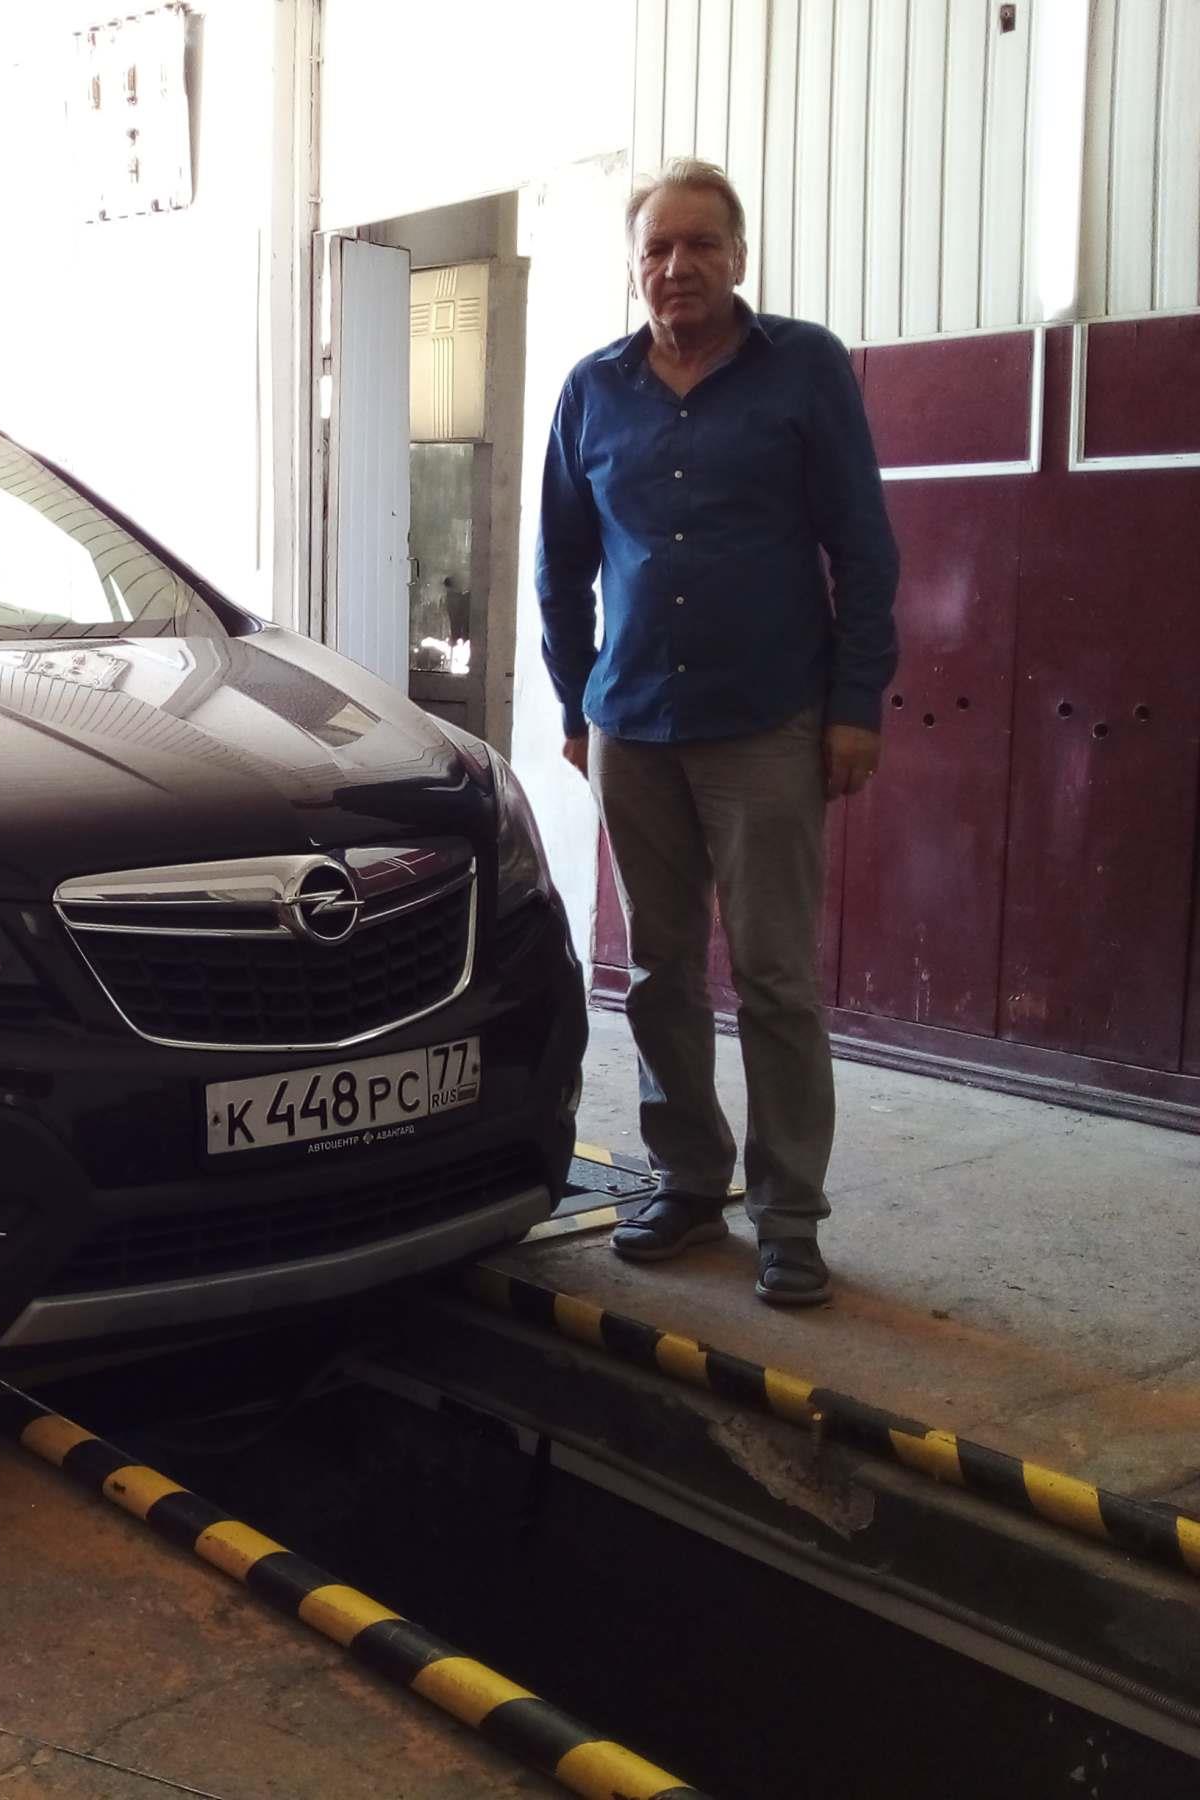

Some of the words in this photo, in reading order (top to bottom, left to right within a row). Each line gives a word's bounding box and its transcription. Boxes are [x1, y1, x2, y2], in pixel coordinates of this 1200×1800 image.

[432, 1043, 468, 1089] 77
[431, 1088, 457, 1109] RUS
[307, 1135, 359, 1153] АВТОЦЕНТР
